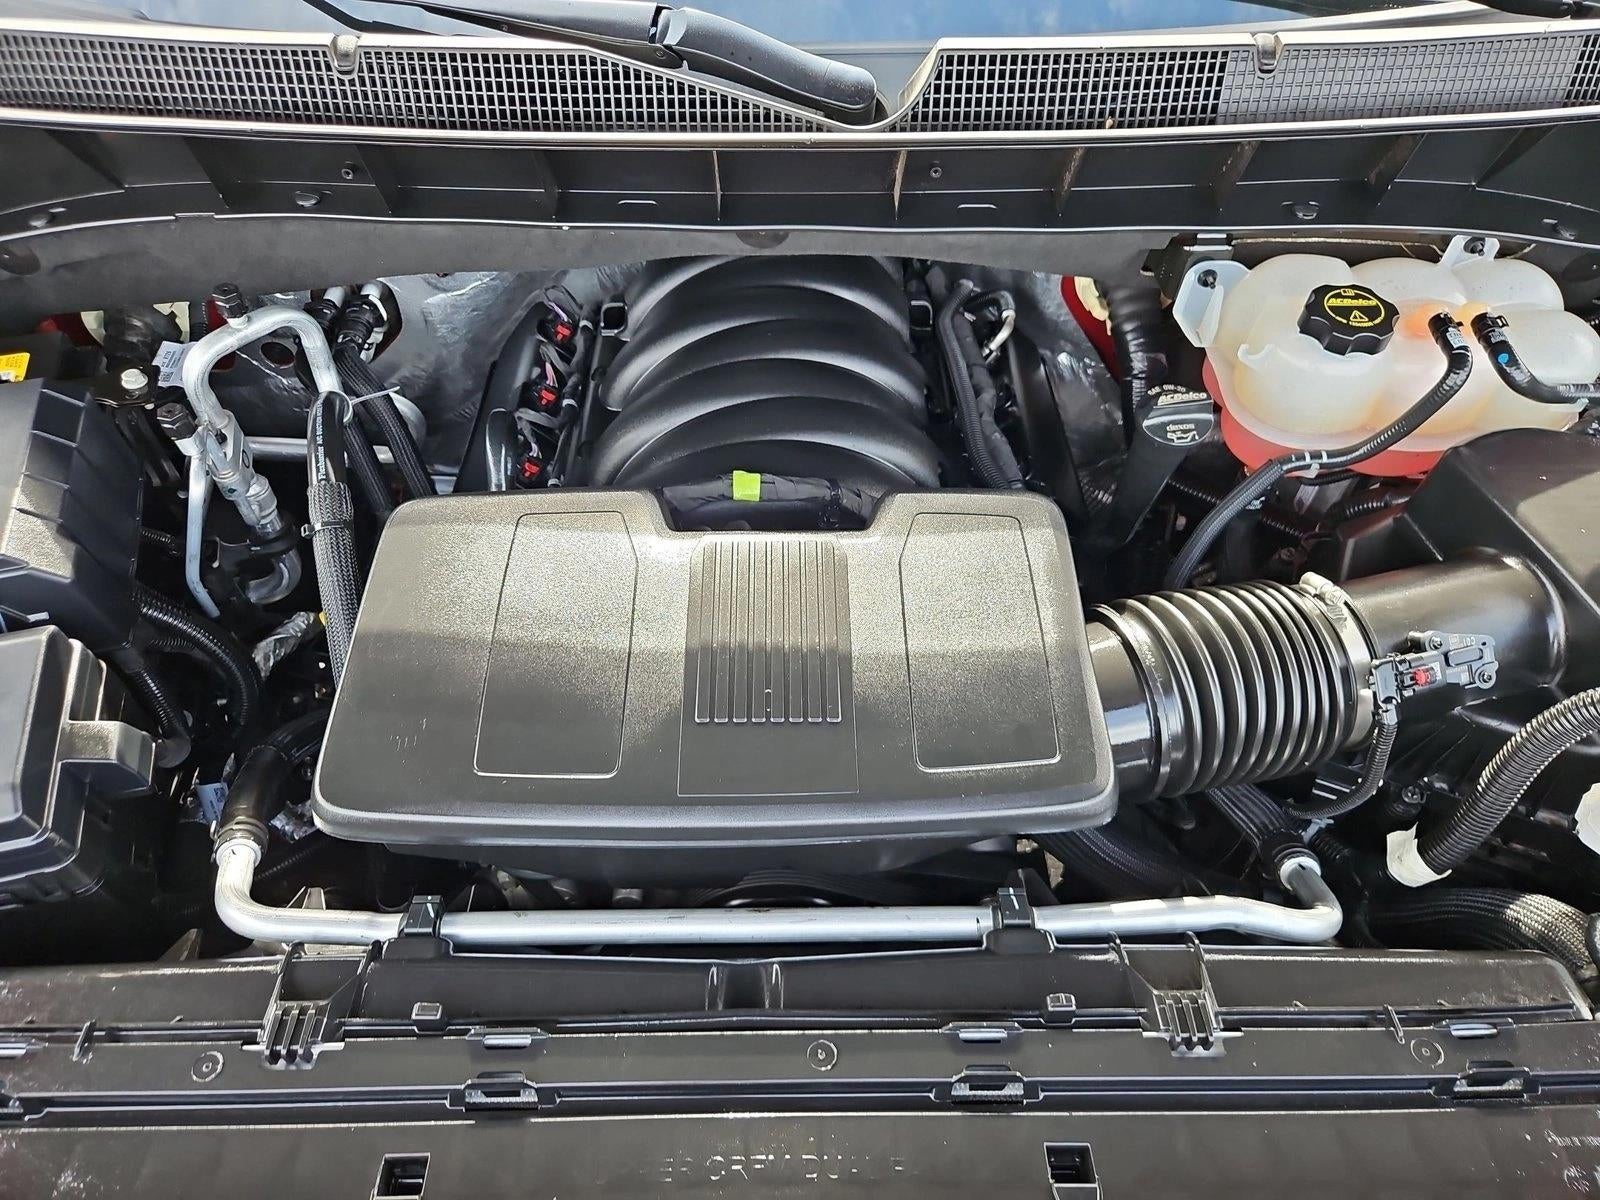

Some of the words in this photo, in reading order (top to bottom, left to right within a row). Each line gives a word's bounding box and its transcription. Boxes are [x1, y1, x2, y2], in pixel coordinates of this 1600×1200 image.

[1327, 297, 1377, 307] ACDelco
[1147, 385, 1162, 396] SAE
[1157, 392, 1208, 405] ACDelco
[1166, 423, 1195, 432] dexos
